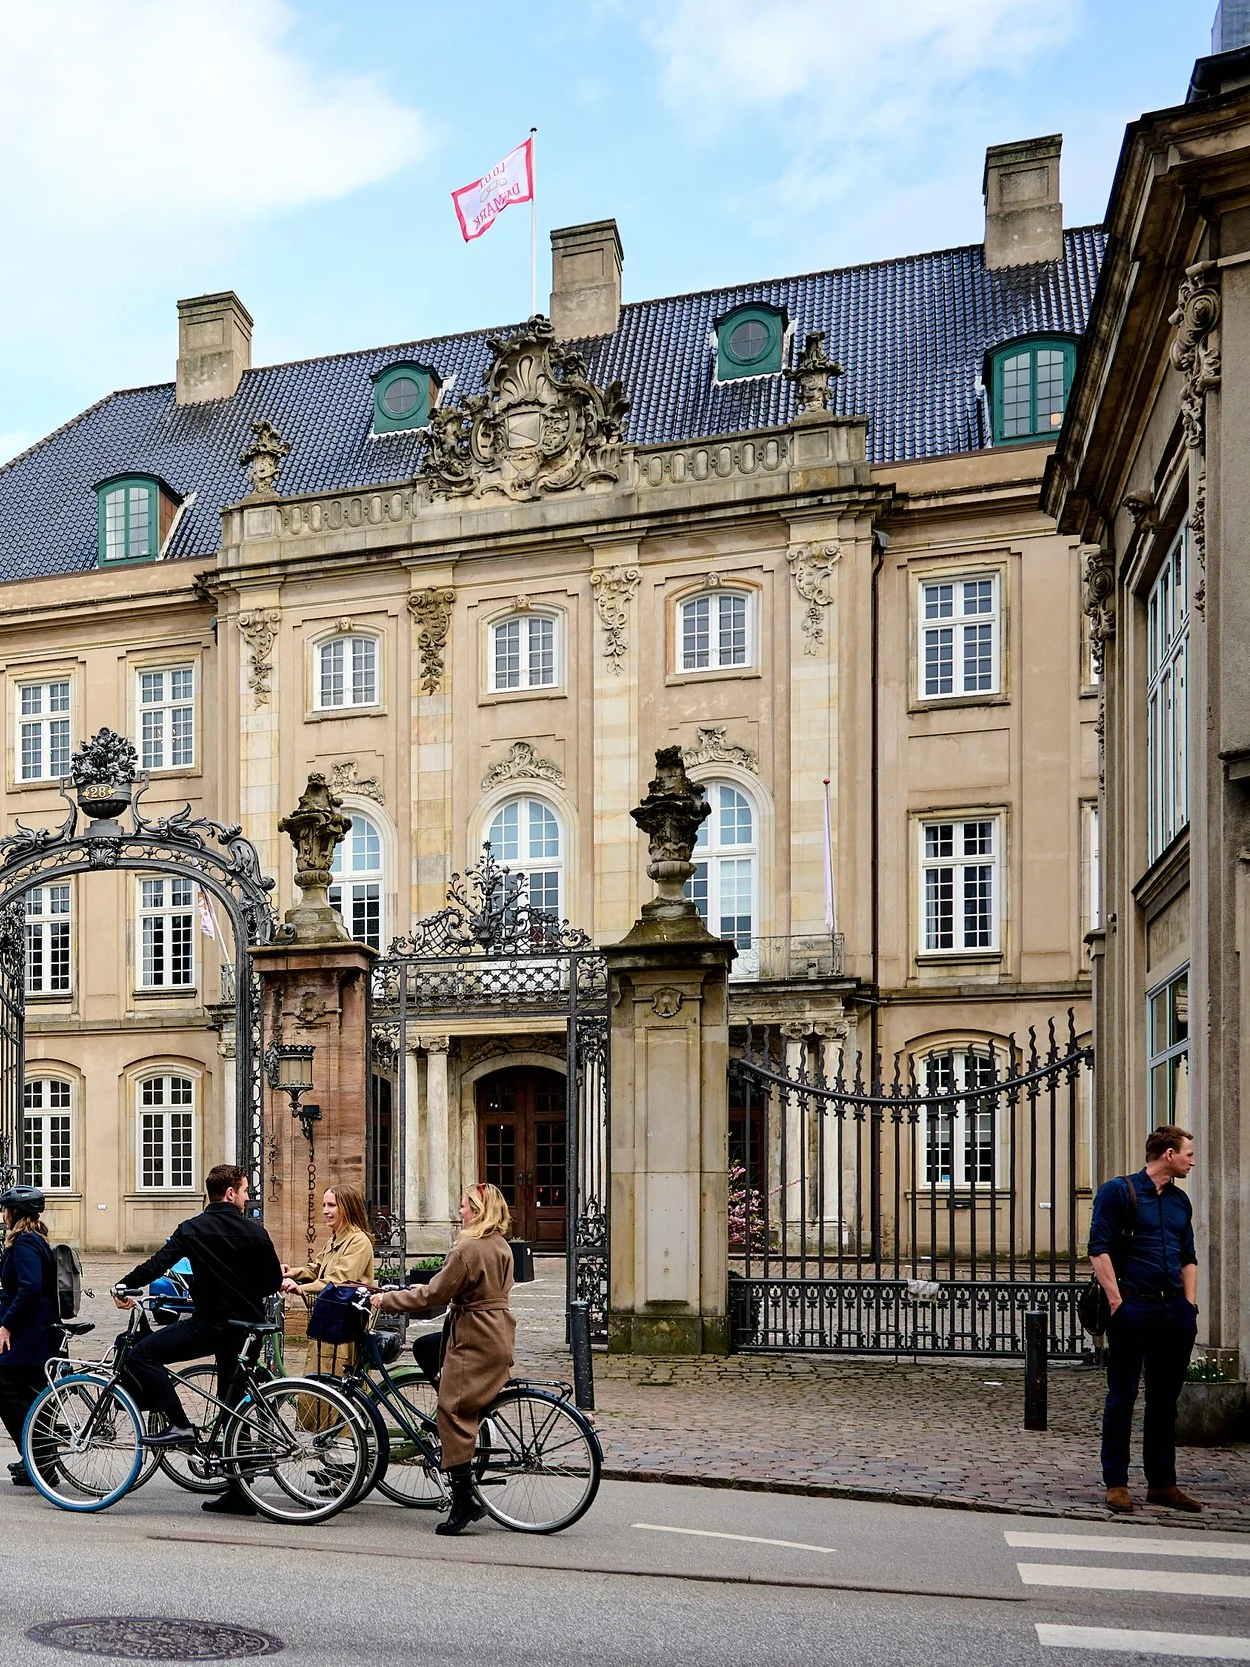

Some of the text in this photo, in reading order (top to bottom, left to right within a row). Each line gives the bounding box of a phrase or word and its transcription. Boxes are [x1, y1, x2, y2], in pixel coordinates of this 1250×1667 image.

[91, 786, 106, 798] 28
[307, 1164, 316, 1190] ODD
[305, 1194, 317, 1243] FELLOW
